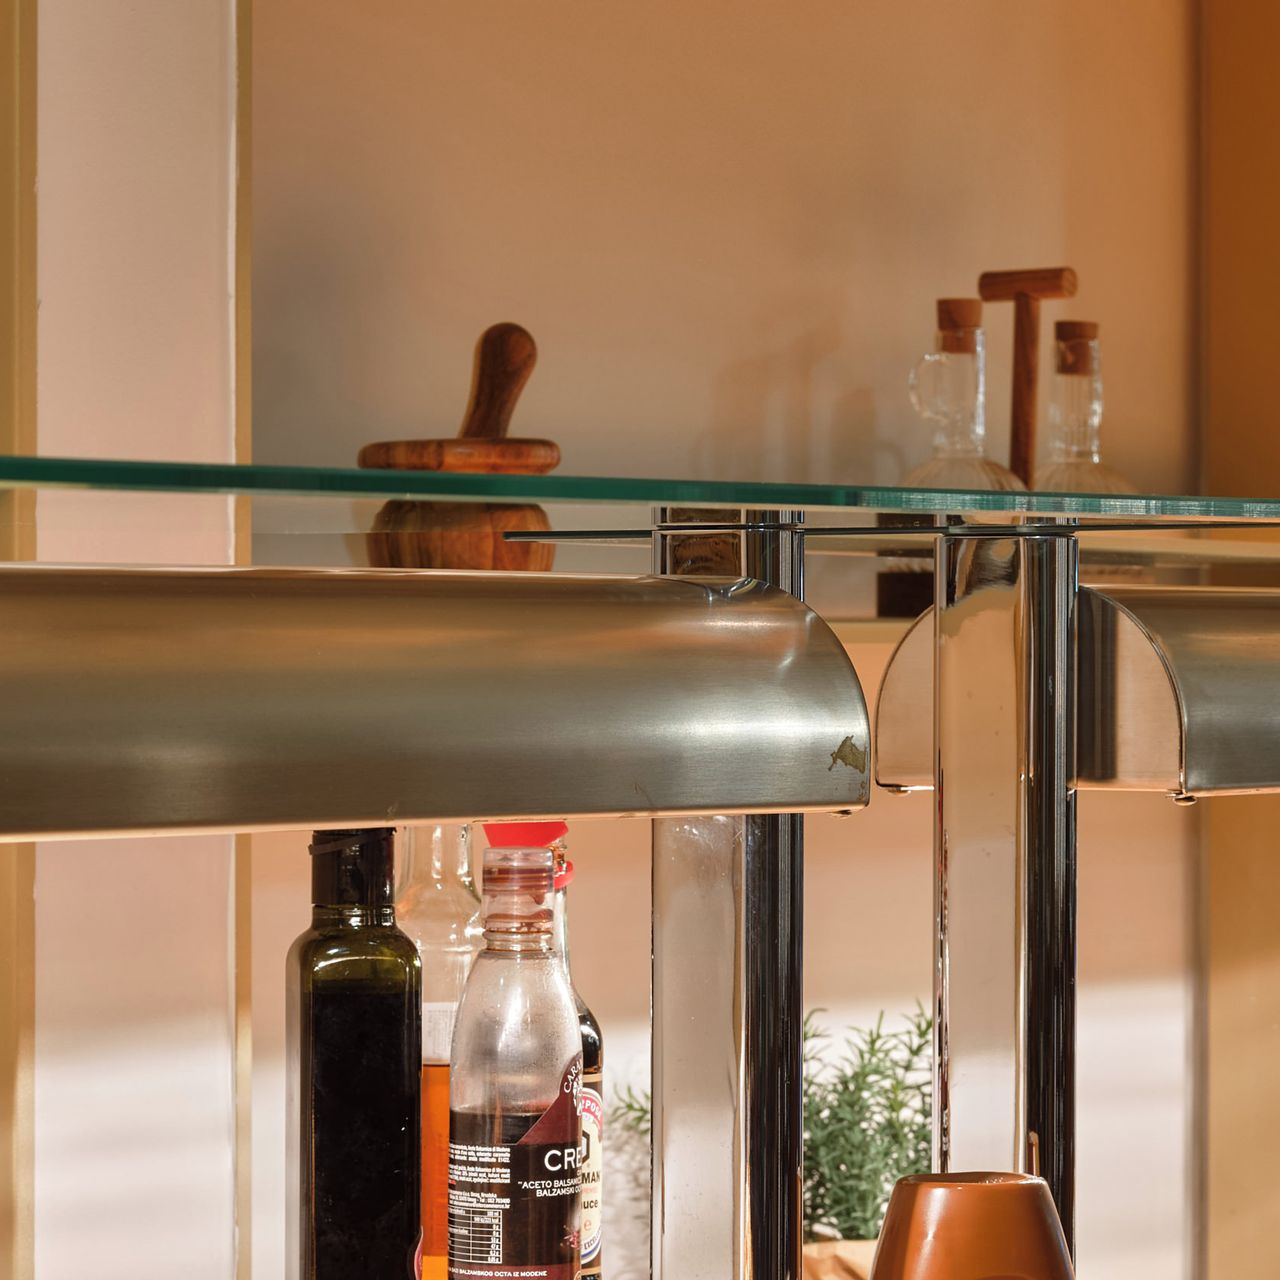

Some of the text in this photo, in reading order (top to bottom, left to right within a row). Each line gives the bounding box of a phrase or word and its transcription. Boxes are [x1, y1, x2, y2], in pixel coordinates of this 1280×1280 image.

[544, 1147, 582, 1171] CRE
[581, 1171, 600, 1184] MAN
[581, 1200, 598, 1209] uce
